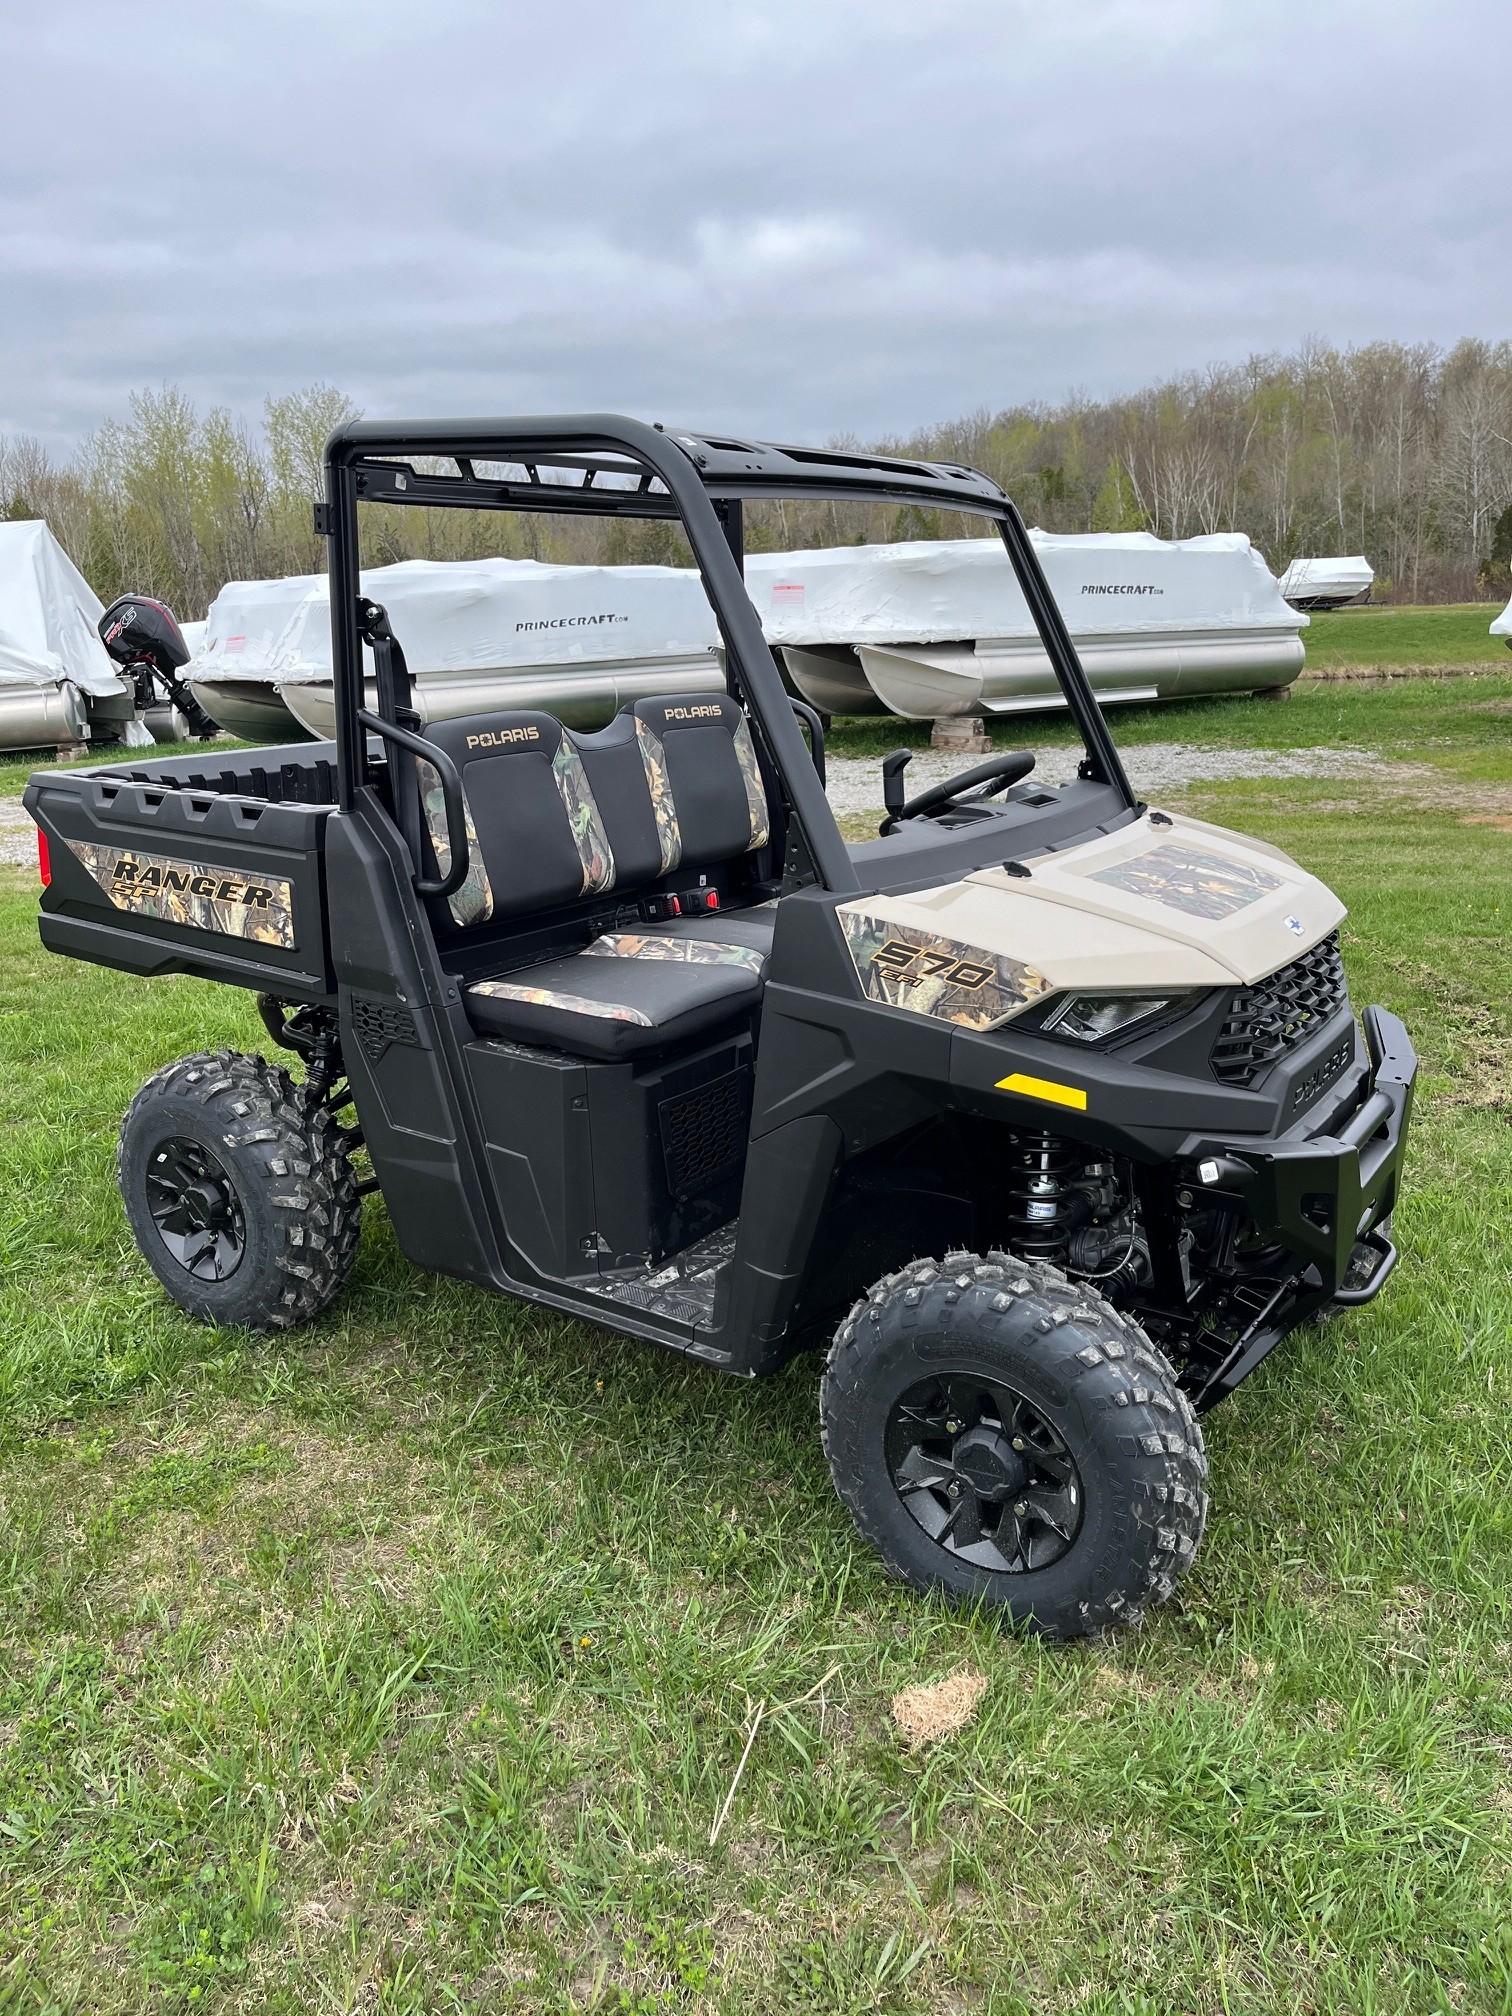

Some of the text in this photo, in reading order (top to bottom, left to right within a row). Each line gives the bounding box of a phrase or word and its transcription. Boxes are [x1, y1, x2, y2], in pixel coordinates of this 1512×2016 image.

[664, 704, 723, 721] POLARIS
[466, 726, 540, 750] POLARIS
[110, 881, 160, 898] SP
[111, 860, 274, 910] RANGER
[870, 939, 996, 991] 570
[879, 967, 925, 988] EFI
